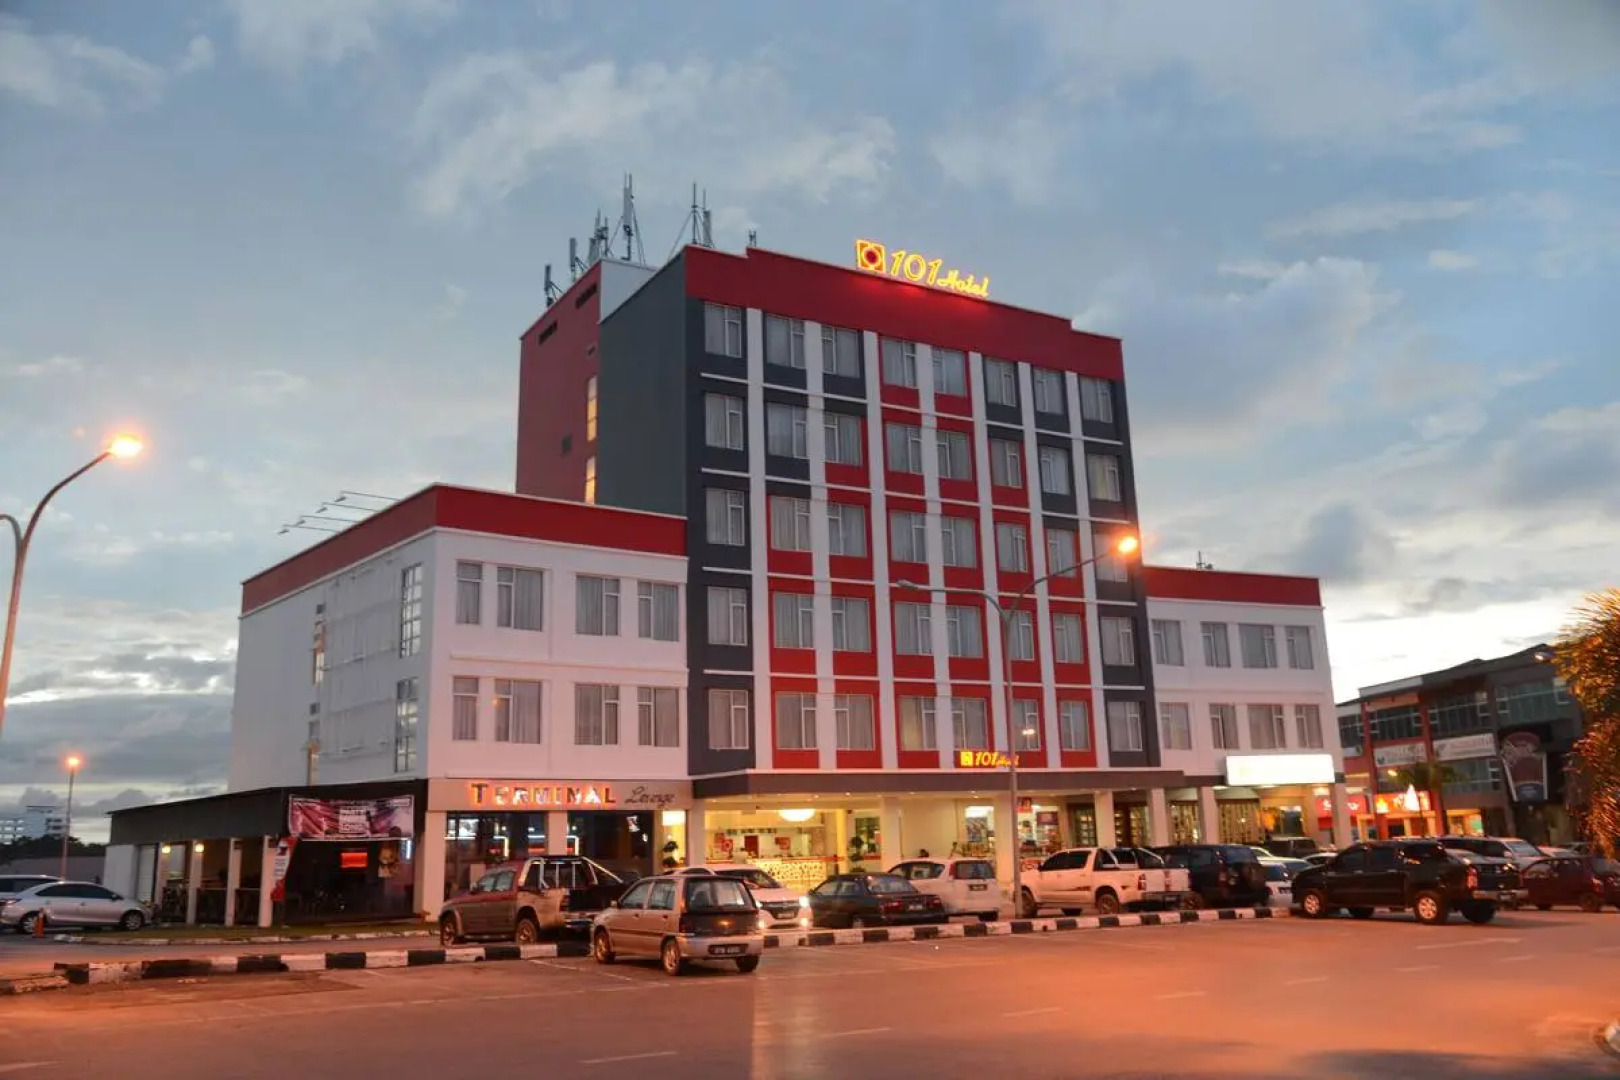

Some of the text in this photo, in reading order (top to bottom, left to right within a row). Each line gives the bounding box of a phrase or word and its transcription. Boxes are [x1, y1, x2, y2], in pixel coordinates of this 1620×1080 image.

[890, 249, 989, 298] 101 Hotel
[975, 751, 999, 767] 101
[471, 783, 617, 805] TERMINAL
